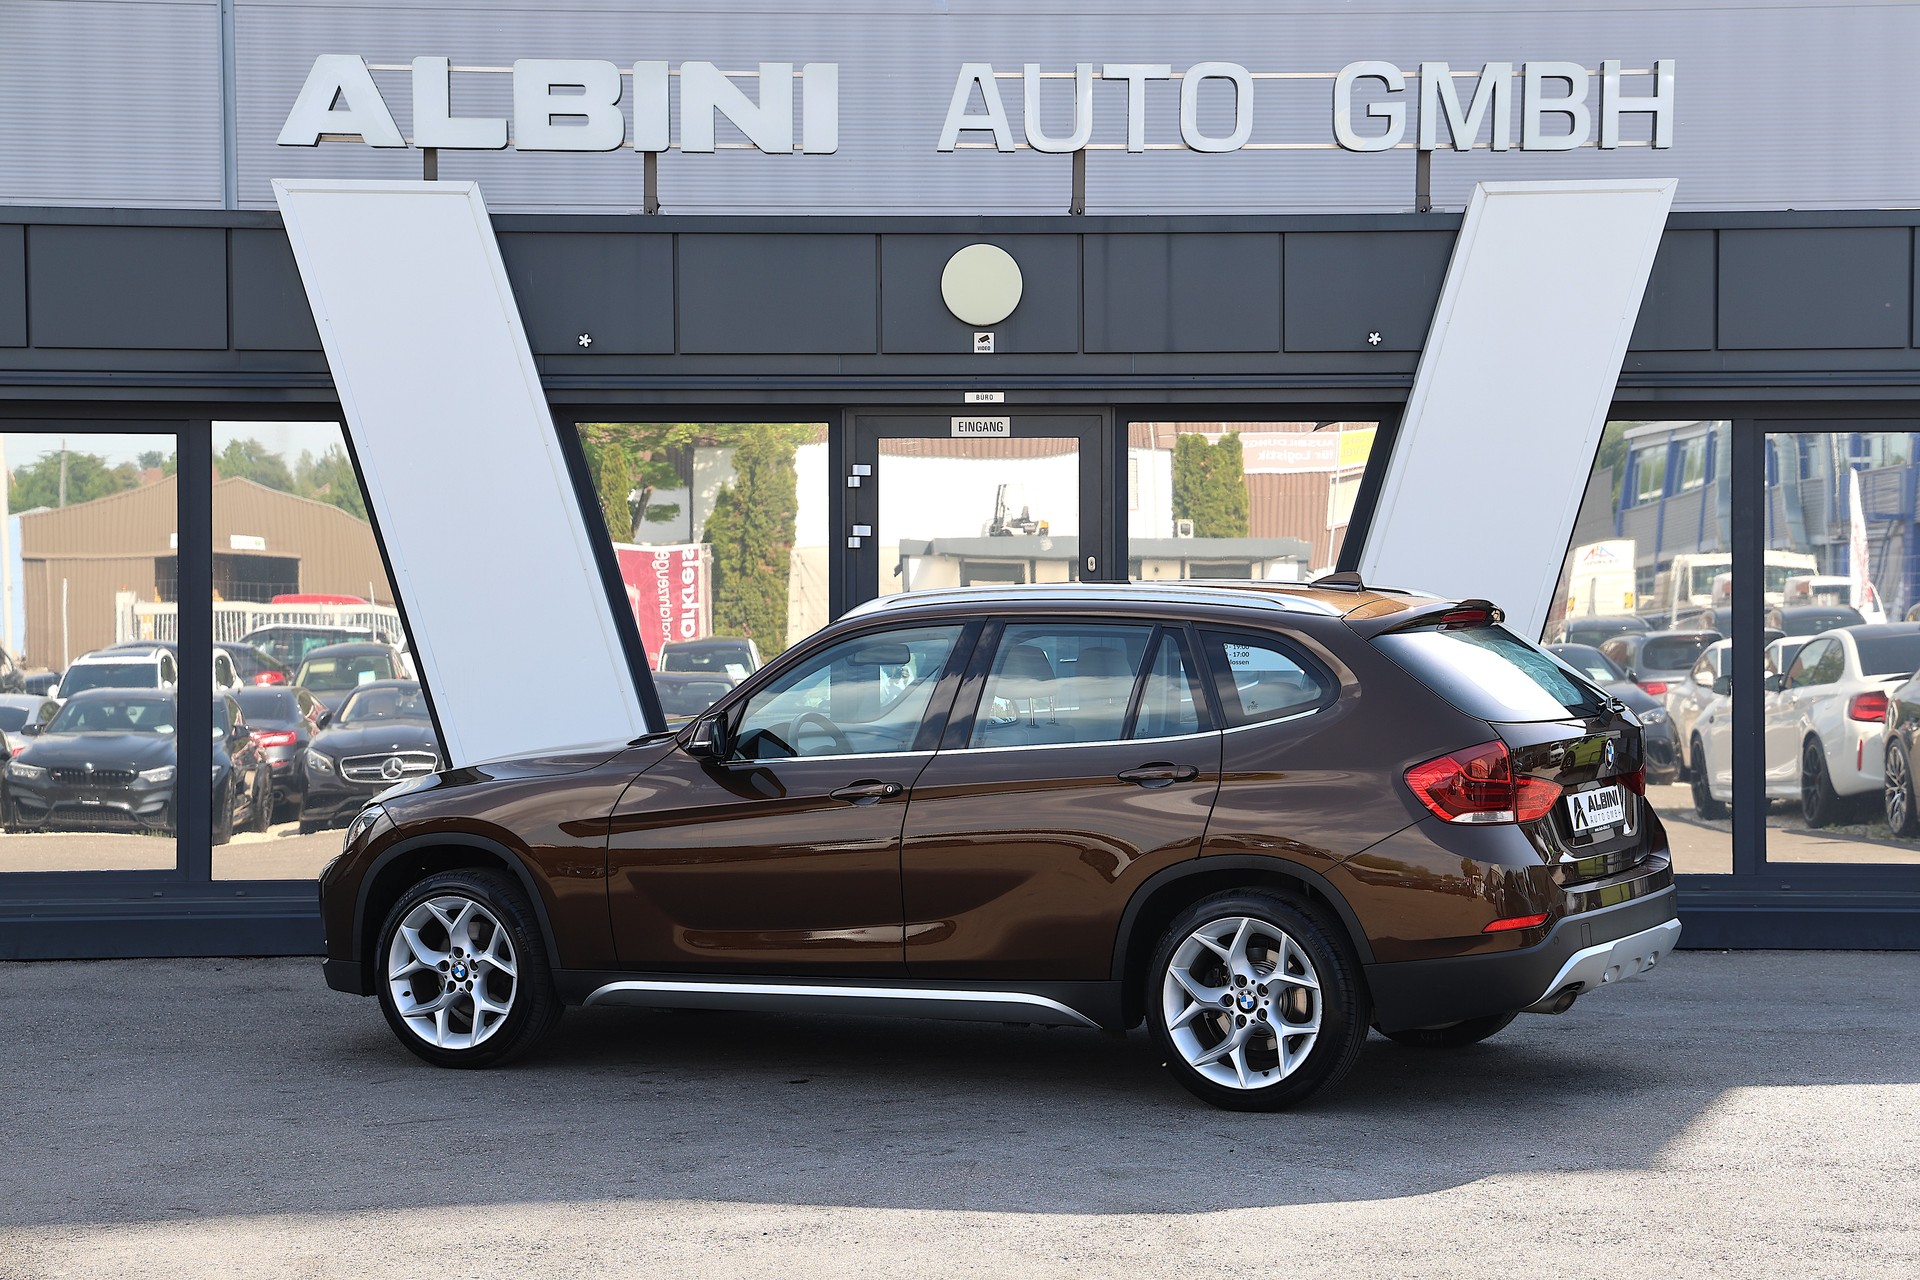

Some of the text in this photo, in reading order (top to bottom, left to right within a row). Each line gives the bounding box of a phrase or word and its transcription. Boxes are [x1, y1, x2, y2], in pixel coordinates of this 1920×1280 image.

[276, 54, 1676, 154] ALBINI AUTO GMBH
[975, 392, 994, 401] BÜRO
[958, 421, 1004, 432] EINGANG
[1587, 789, 1619, 813] ALBINI
